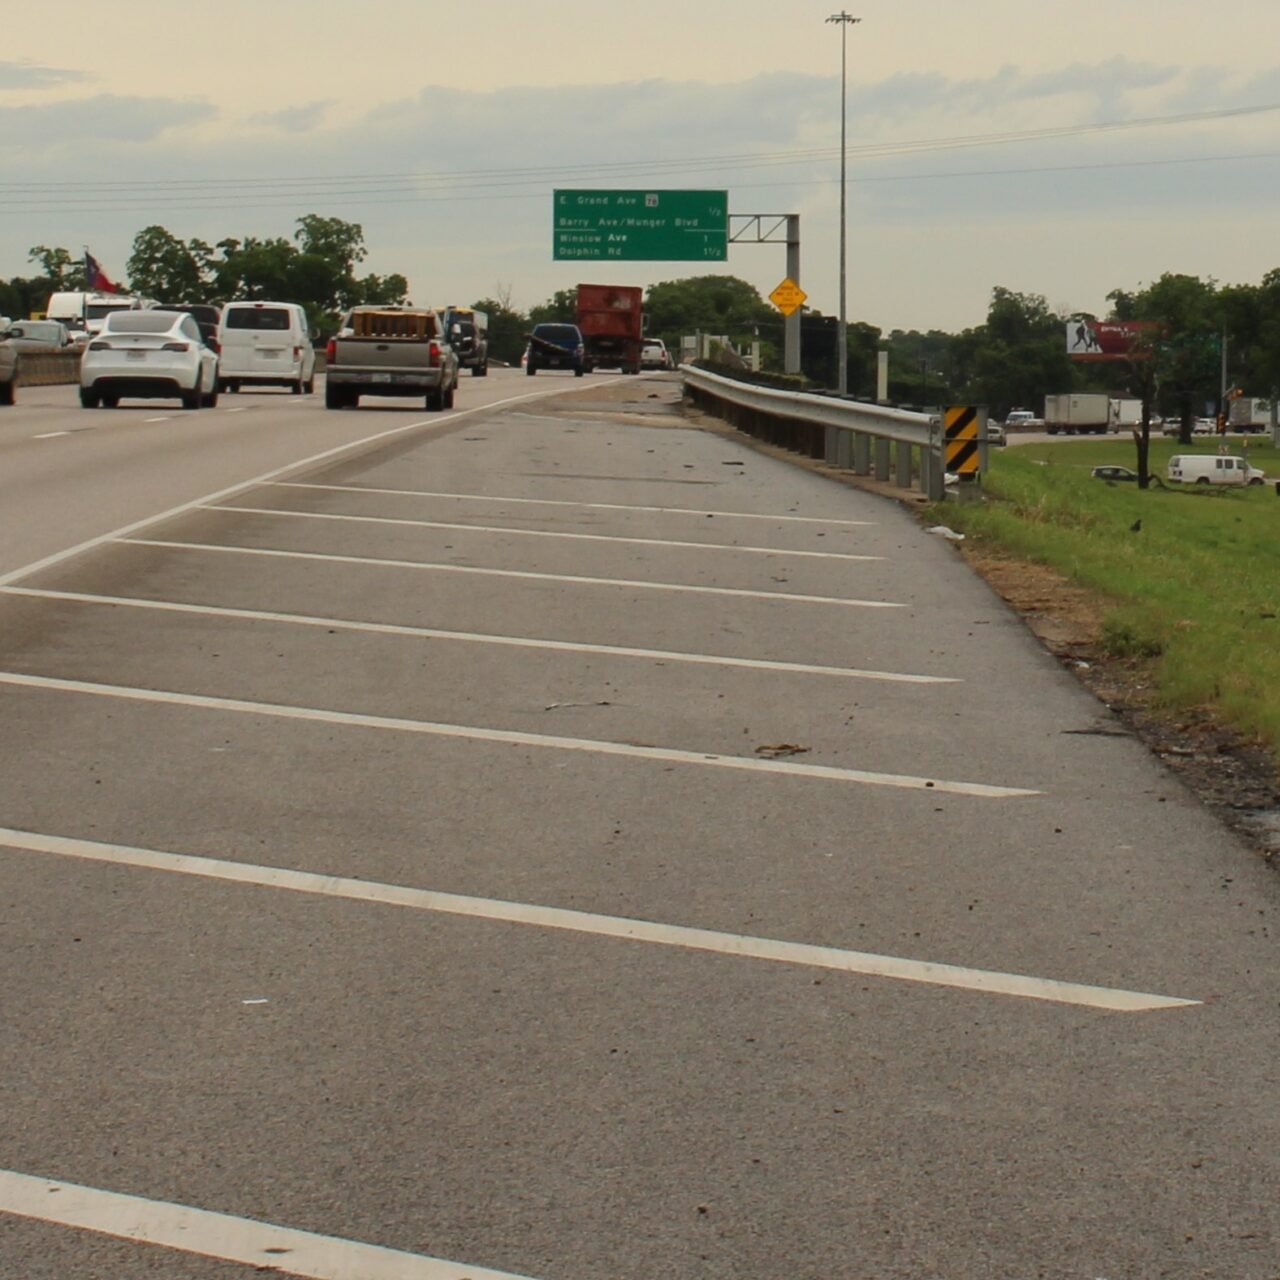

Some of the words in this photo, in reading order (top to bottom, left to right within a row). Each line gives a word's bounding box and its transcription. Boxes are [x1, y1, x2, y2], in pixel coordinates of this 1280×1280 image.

[559, 196, 566, 205] E
[577, 196, 609, 205] Grand
[617, 196, 637, 205] Ave
[559, 218, 589, 228] Barry
[675, 218, 699, 227] Blvd
[560, 234, 602, 243] Winslow
[608, 233, 628, 242] Ave
[559, 247, 600, 256] Dolphin
[608, 247, 622, 256] Rd
